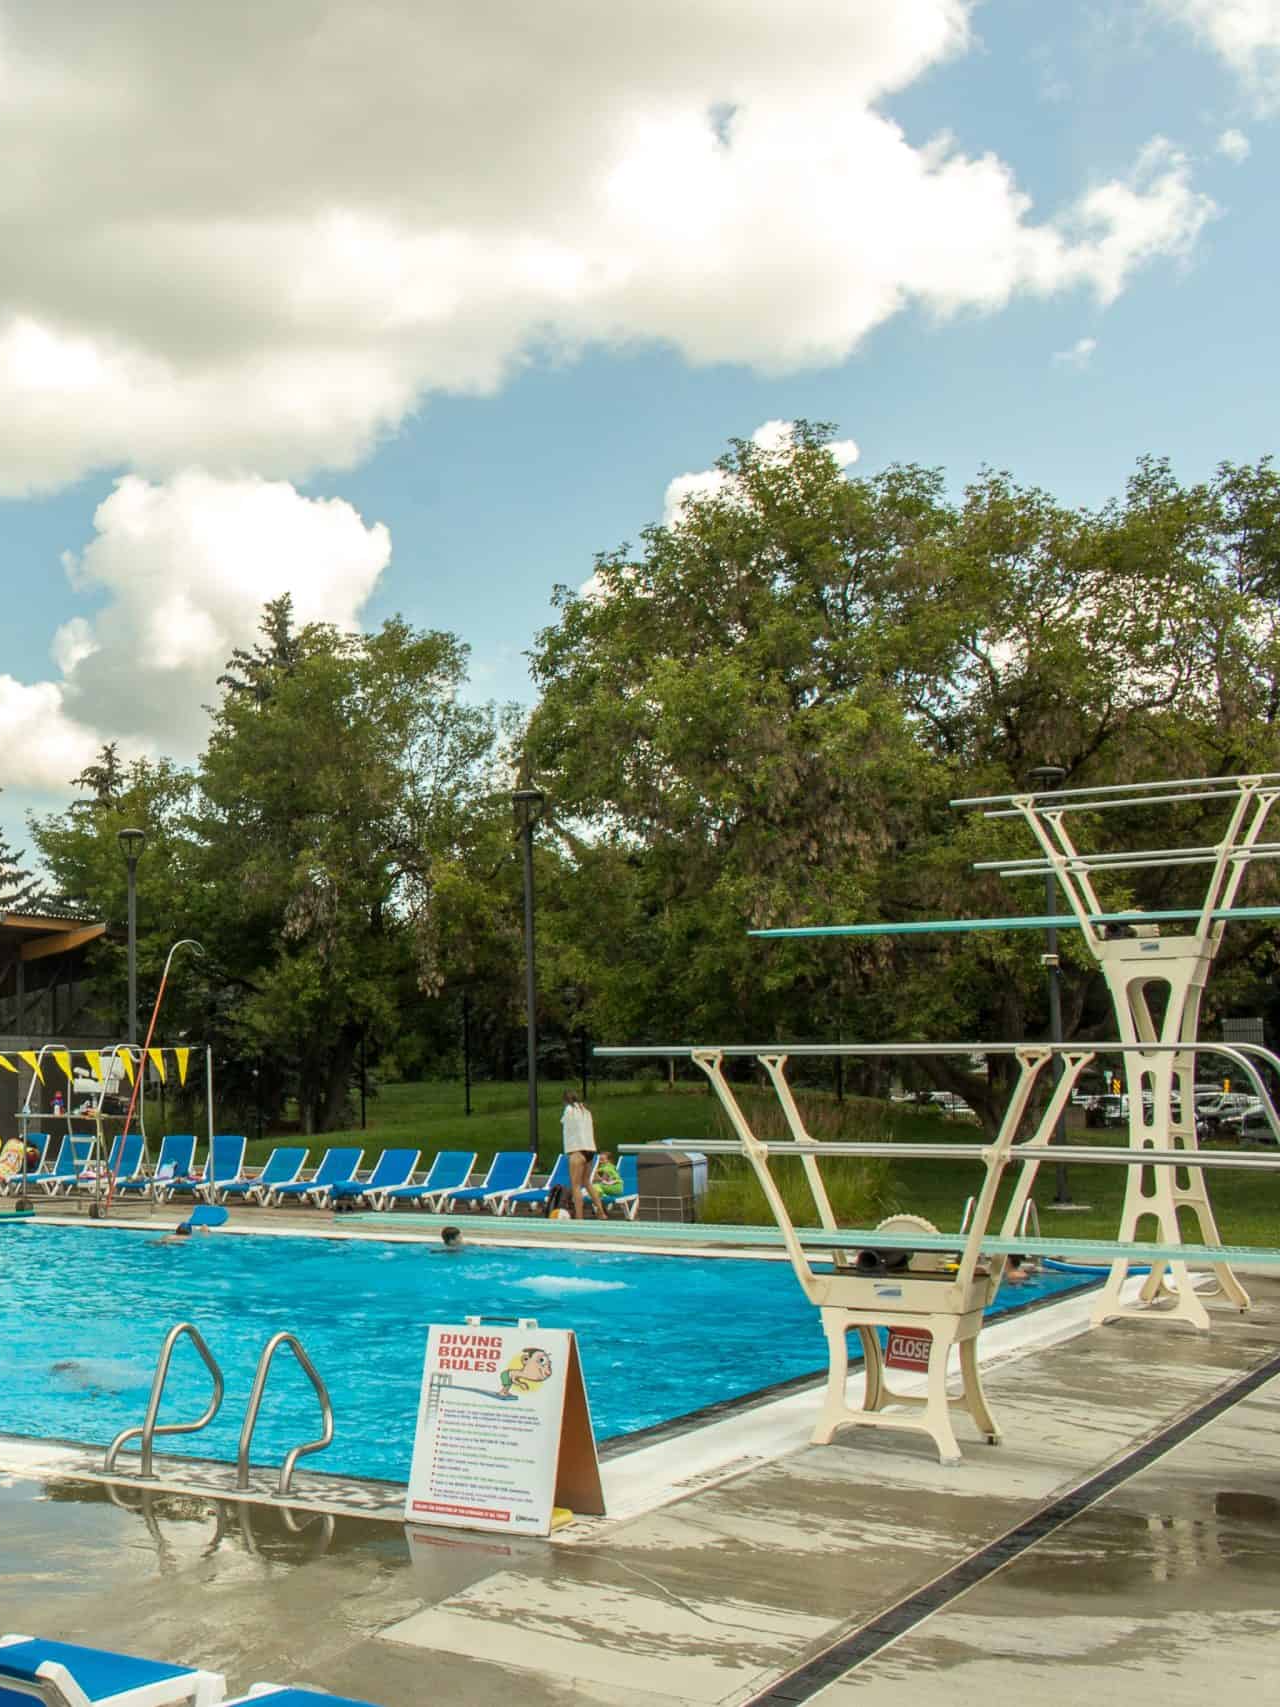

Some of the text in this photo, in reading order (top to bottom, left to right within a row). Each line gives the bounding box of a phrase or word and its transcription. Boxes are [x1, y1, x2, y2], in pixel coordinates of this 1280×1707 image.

[440, 1334, 502, 1347] DIVING
[438, 1346, 500, 1360] BOARD
[891, 1339, 928, 1360] CLOSE
[439, 1358, 497, 1372] RULES
